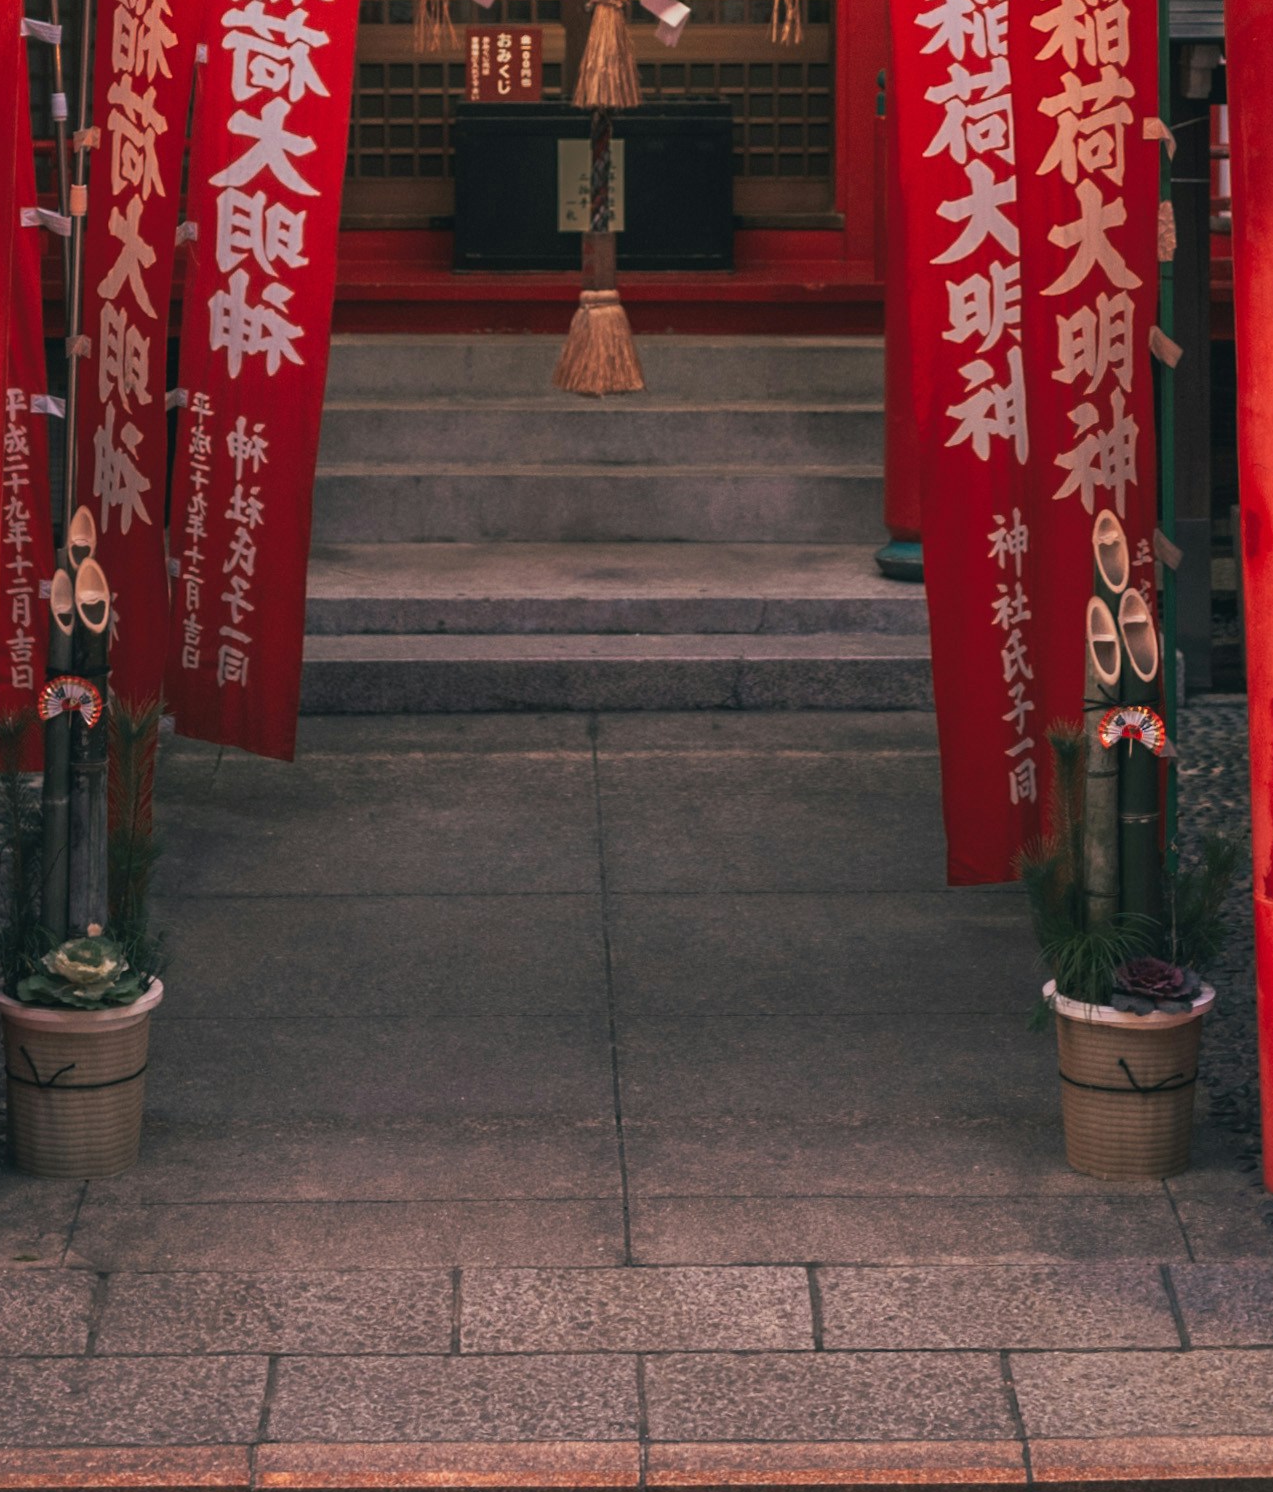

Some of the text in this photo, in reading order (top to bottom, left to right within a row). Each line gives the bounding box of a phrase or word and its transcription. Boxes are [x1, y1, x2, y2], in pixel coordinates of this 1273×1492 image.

[496, 32, 513, 95] おみくじ
[986, 506, 1038, 807] 神社氏子一同
